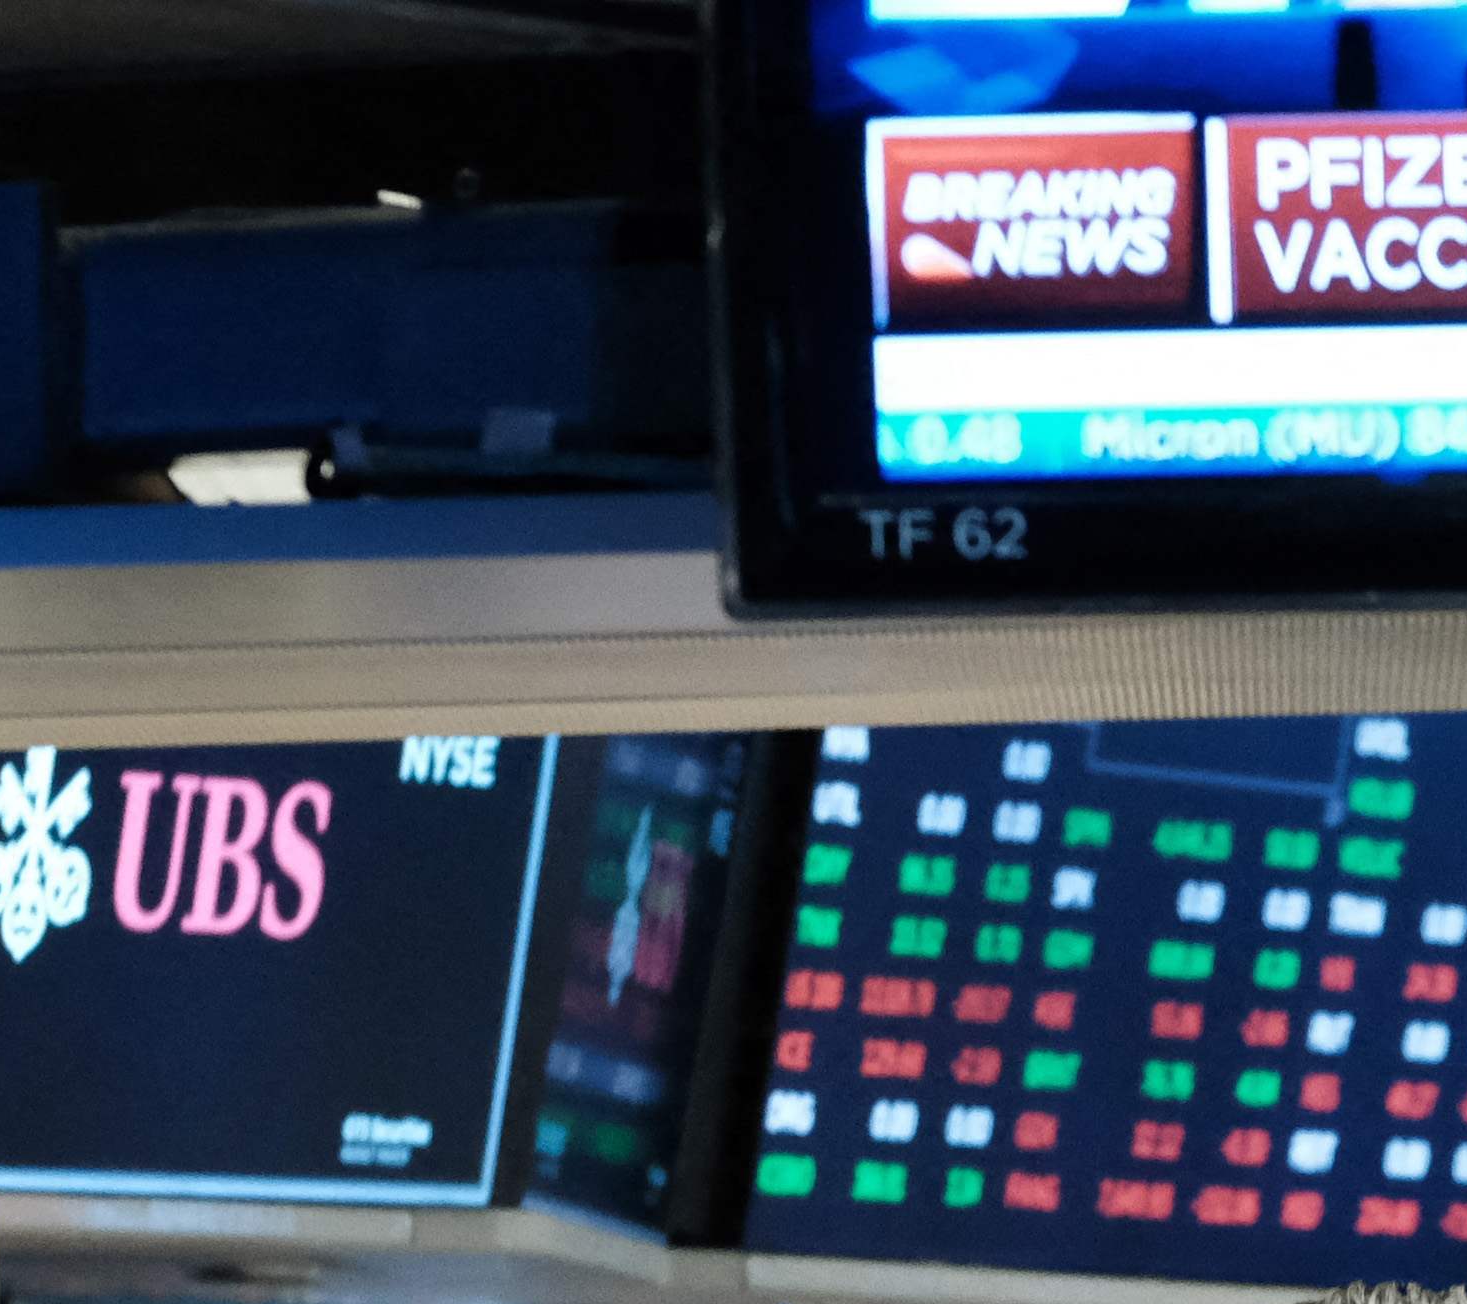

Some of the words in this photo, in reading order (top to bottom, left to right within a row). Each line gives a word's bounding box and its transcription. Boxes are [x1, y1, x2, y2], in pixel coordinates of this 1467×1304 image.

[903, 165, 1177, 222] BREAKING
[971, 218, 1170, 277] NEWS
[1080, 410, 1259, 464] Micron
[1265, 406, 1401, 463] (MU)
[858, 508, 934, 559] TF
[952, 506, 1029, 562] 62
[398, 735, 502, 789] NYSE
[113, 769, 332, 942] UBS
